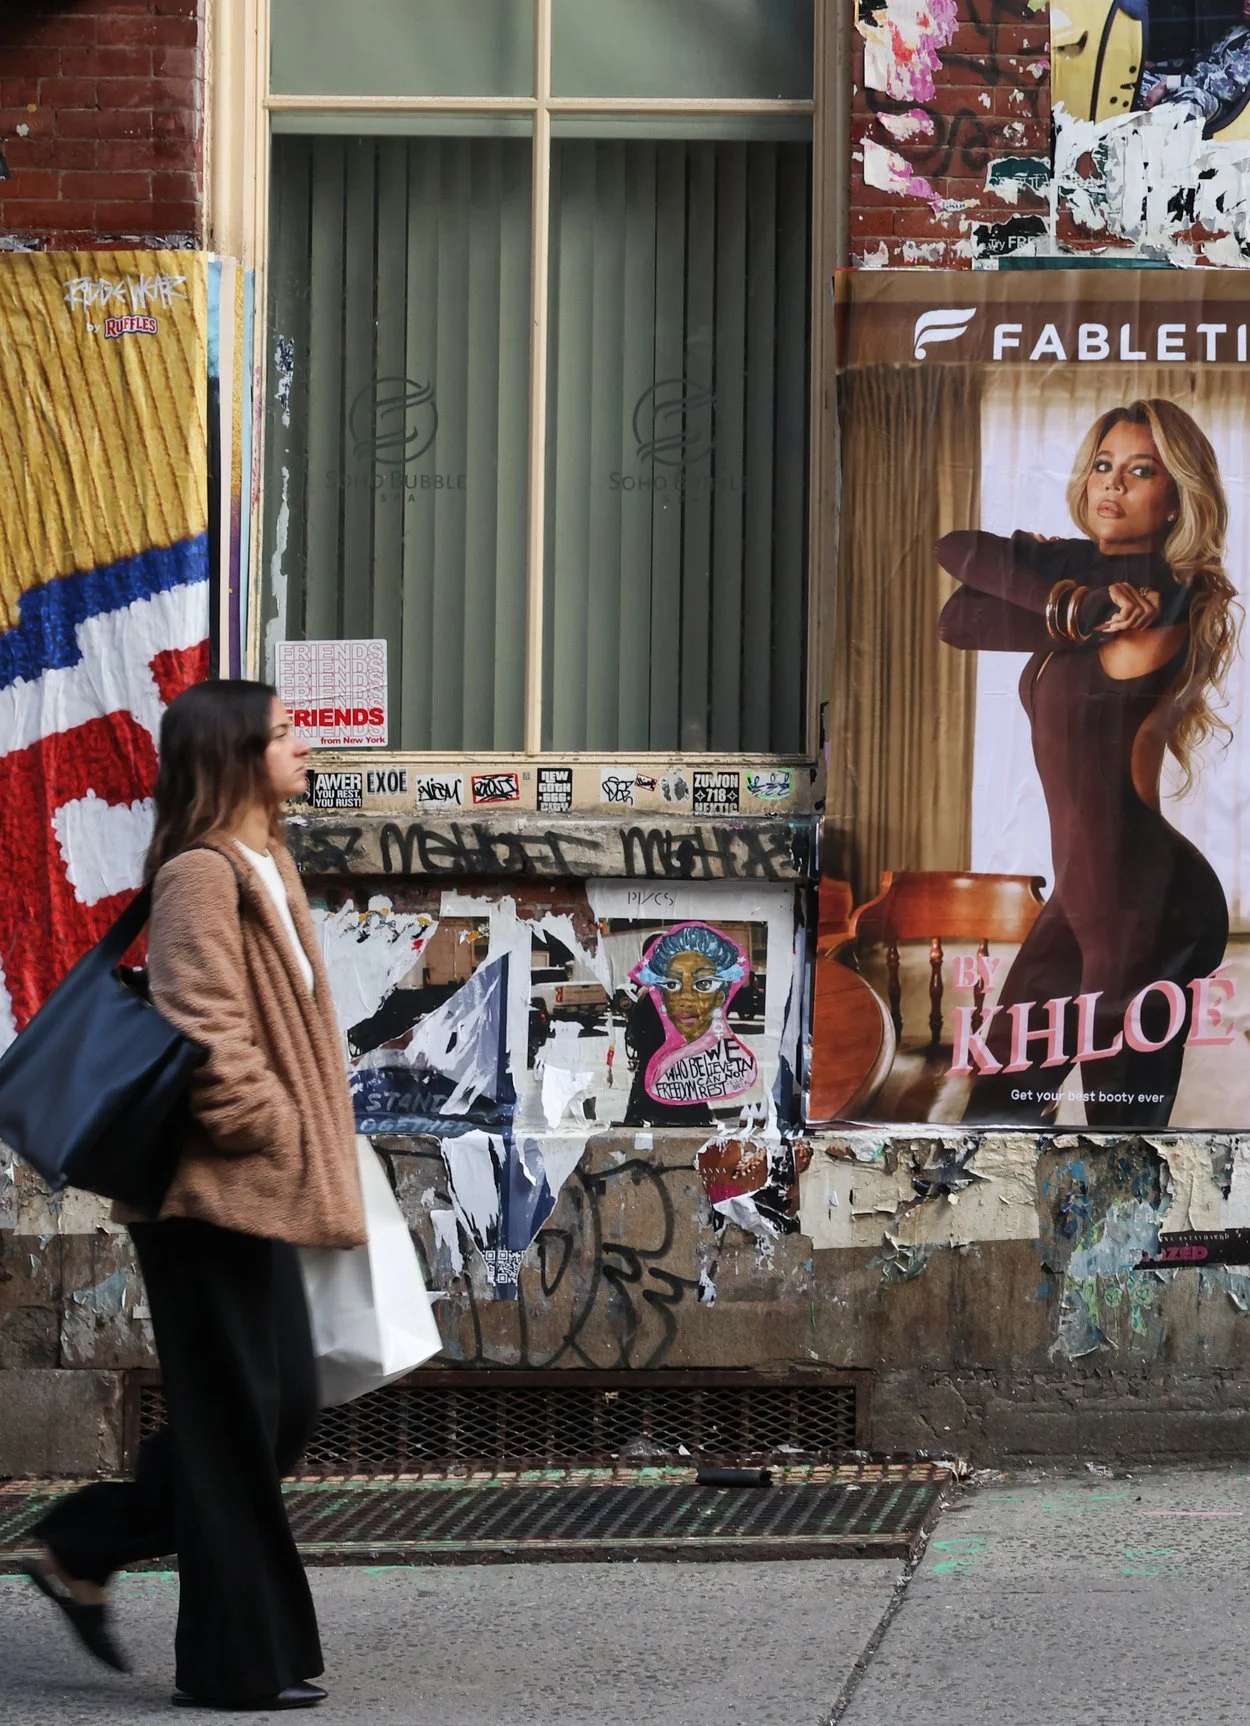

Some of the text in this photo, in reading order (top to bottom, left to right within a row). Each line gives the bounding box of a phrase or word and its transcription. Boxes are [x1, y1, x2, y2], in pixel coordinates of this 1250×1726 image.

[87, 315, 157, 338] by RUFFLES
[279, 643, 384, 661] FRIENDS
[320, 736, 386, 745] from New York
[315, 773, 362, 790] AWER
[541, 771, 569, 783] NEW
[694, 773, 738, 788] ZUWON
[317, 789, 335, 798] YOU
[538, 782, 571, 793] GOTH
[705, 788, 727, 802] 718
[315, 798, 362, 808] YOU RUST!
[951, 955, 1001, 994] BY
[943, 958, 1239, 1077] KHLOÉ
[704, 1037, 742, 1062] WE
[665, 1059, 689, 1081] WHO
[689, 1055, 733, 1079] BELIEVE
[697, 1075, 721, 1086] CAN
[725, 1070, 745, 1081] NOT
[699, 1081, 728, 1098] REST
[1010, 1089, 1165, 1105] Get your best booty ever
